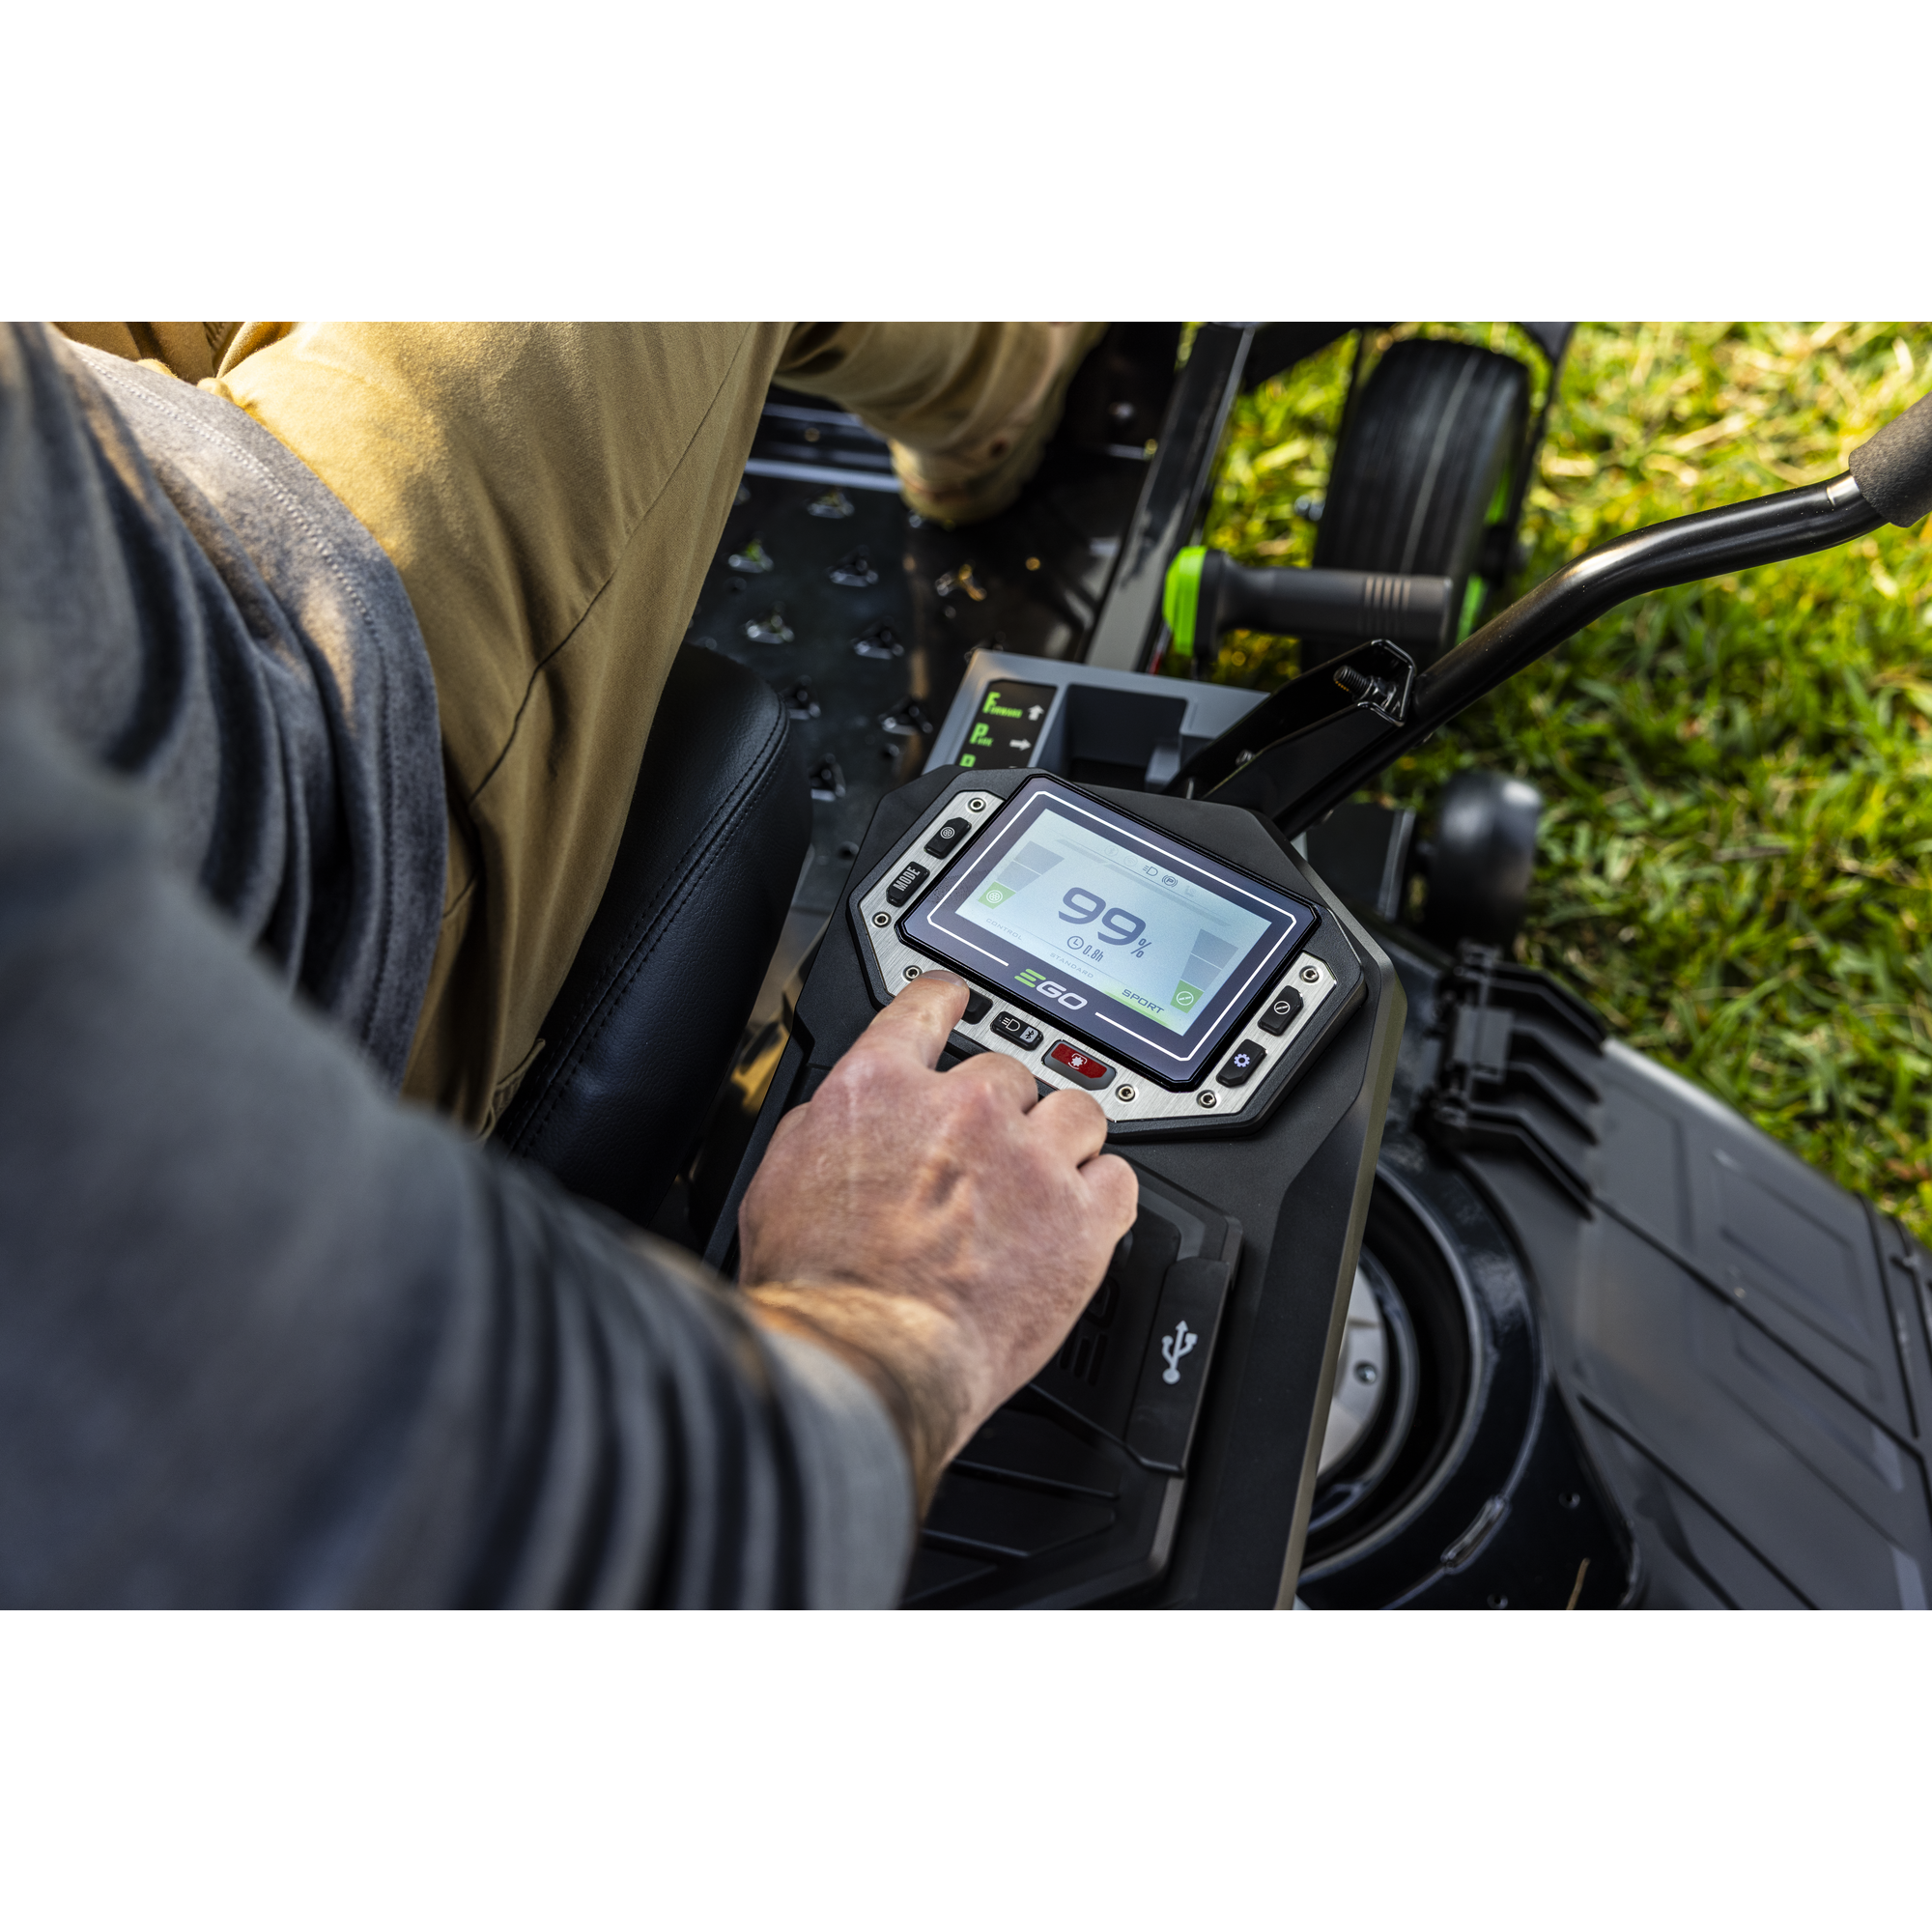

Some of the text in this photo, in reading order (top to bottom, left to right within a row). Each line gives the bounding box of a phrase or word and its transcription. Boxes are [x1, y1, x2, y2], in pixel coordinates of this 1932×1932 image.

[893, 866, 921, 892] MODE
[985, 918, 1022, 941] CONTROL
[1049, 952, 1094, 979] STANDARD
[1082, 945, 1104, 963] 0.8h
[1014, 969, 1088, 1010] EGO
[1122, 988, 1165, 1014] SPORT
